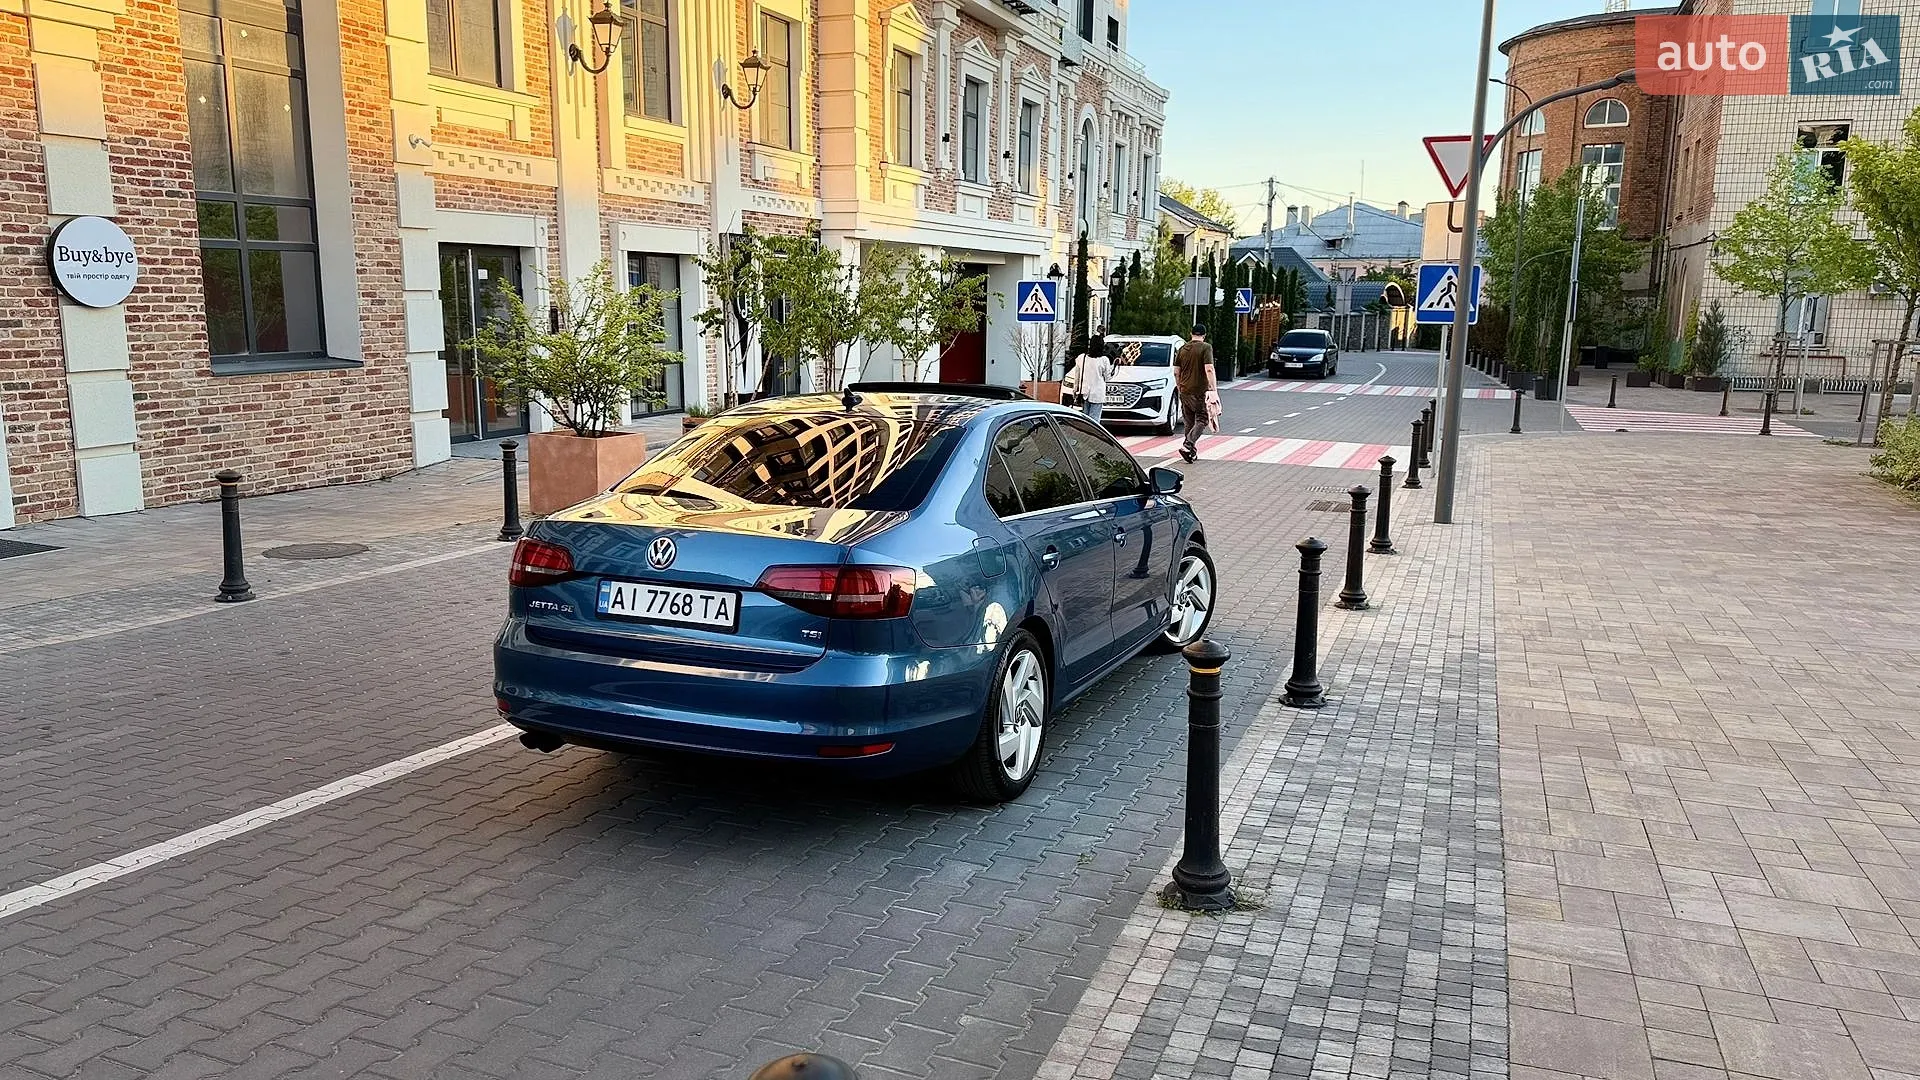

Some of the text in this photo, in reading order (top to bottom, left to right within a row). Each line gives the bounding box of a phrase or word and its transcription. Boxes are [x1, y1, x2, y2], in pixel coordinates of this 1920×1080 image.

[57, 245, 134, 268] Buy&bye
[66, 272, 131, 281] твій простір одягу
[529, 600, 559, 611] JETTA
[611, 586, 730, 621] AI 7768 TA
